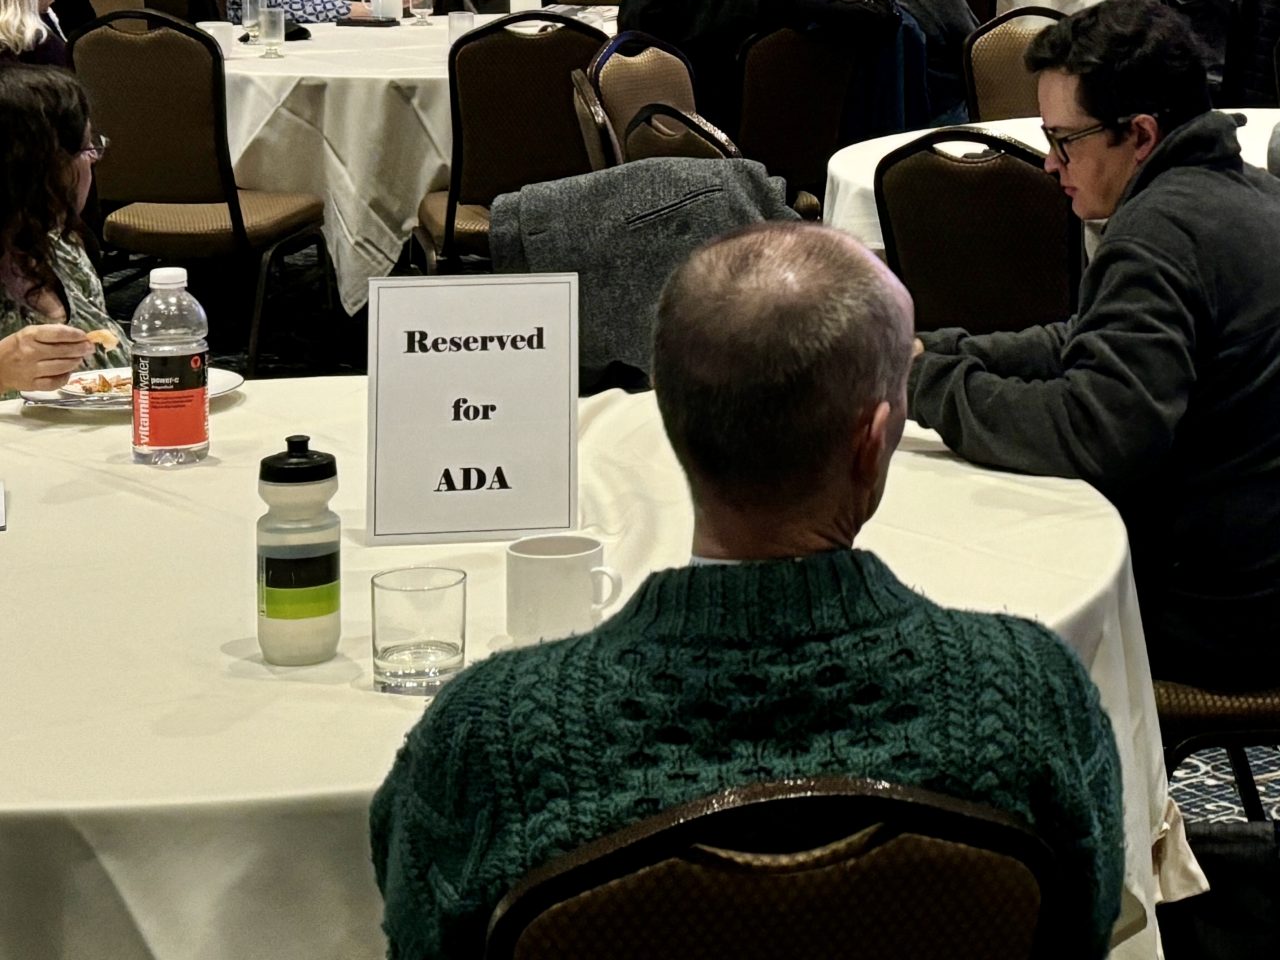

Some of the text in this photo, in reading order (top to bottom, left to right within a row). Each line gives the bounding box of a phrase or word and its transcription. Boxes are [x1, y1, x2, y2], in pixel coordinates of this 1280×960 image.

[403, 327, 546, 354] Reserved
[138, 357, 150, 445] vitaminwater
[451, 398, 497, 421] for
[433, 466, 512, 492] ADA
